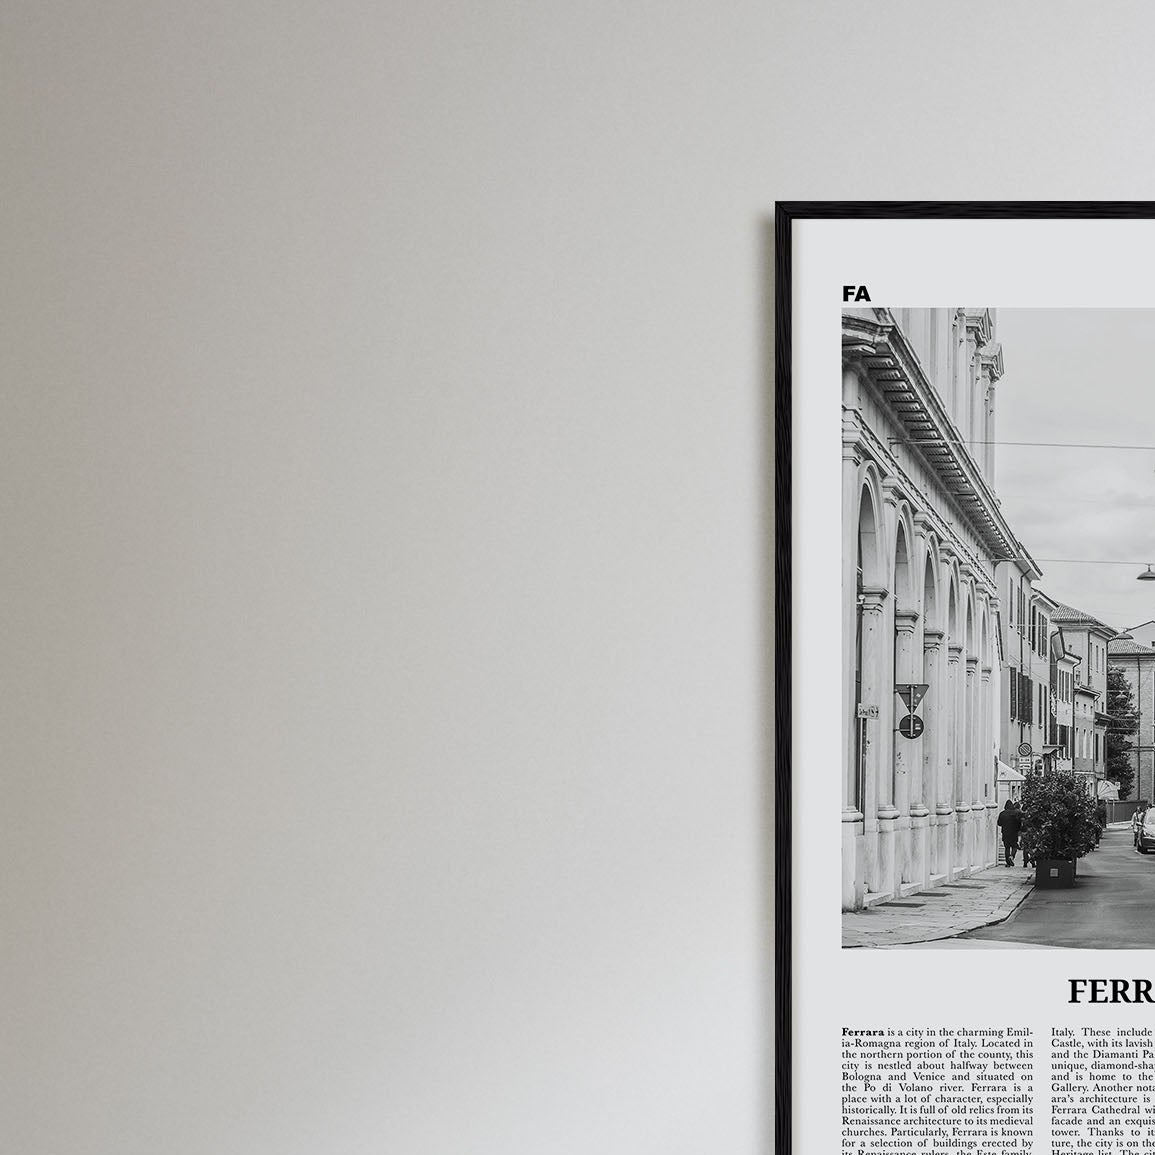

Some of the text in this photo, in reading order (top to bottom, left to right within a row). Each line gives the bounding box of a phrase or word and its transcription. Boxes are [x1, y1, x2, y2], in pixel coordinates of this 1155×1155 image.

[842, 285, 872, 302] FA
[841, 1028, 885, 1037] Ferrara
[887, 1028, 896, 1037] is
[905, 1028, 924, 1039] city
[926, 1028, 936, 1037] in
[938, 1028, 955, 1037] the
[956, 1028, 1004, 1039] charming
[1006, 1028, 1034, 1037] Emil-
[1051, 1028, 1075, 1039] Italy.
[1080, 1028, 1111, 1037] These
[1116, 1028, 1153, 1037] include
[841, 1039, 1034, 1050] ia-Romagna region of Italy. Located in
[1051, 1039, 1085, 1049] Castle,
[1087, 1039, 1109, 1048] with
[1111, 1039, 1123, 1048] its
[1125, 1039, 1154, 1048] lavish
[1050, 1050, 1070, 1059] and
[1073, 1050, 1089, 1059] the
[1092, 1050, 1139, 1059] Diamanti
[841, 1061, 1033, 1072] city is nestled about halfway between
[1051, 1061, 1088, 1072] unique,
[841, 1072, 882, 1083] Bologna
[887, 1072, 907, 1081] and
[912, 1072, 946, 1081] Venice
[951, 1072, 970, 1081] and
[976, 1072, 1015, 1081] situated
[1051, 1083, 1089, 1095] Gallery.
[1092, 1083, 1134, 1092] Another
[841, 1094, 868, 1106] place
[870, 1094, 892, 1103] with
[904, 1094, 918, 1103] lot
[920, 1094, 932, 1103] of
[934, 1094, 984, 1104] character,
[986, 1094, 1034, 1106] especially
[1079, 1094, 1138, 1103] architecture
[1143, 1094, 1151, 1103] is
[1051, 1117, 1083, 1125] facade
[1086, 1117, 1105, 1125] and
[841, 1128, 1033, 1139] churches. Particularly, Ferrara is known
[1051, 1139, 1074, 1149] ture,
[1076, 1139, 1093, 1148] the
[1094, 1139, 1114, 1150] city
[1115, 1139, 1124, 1148] is
